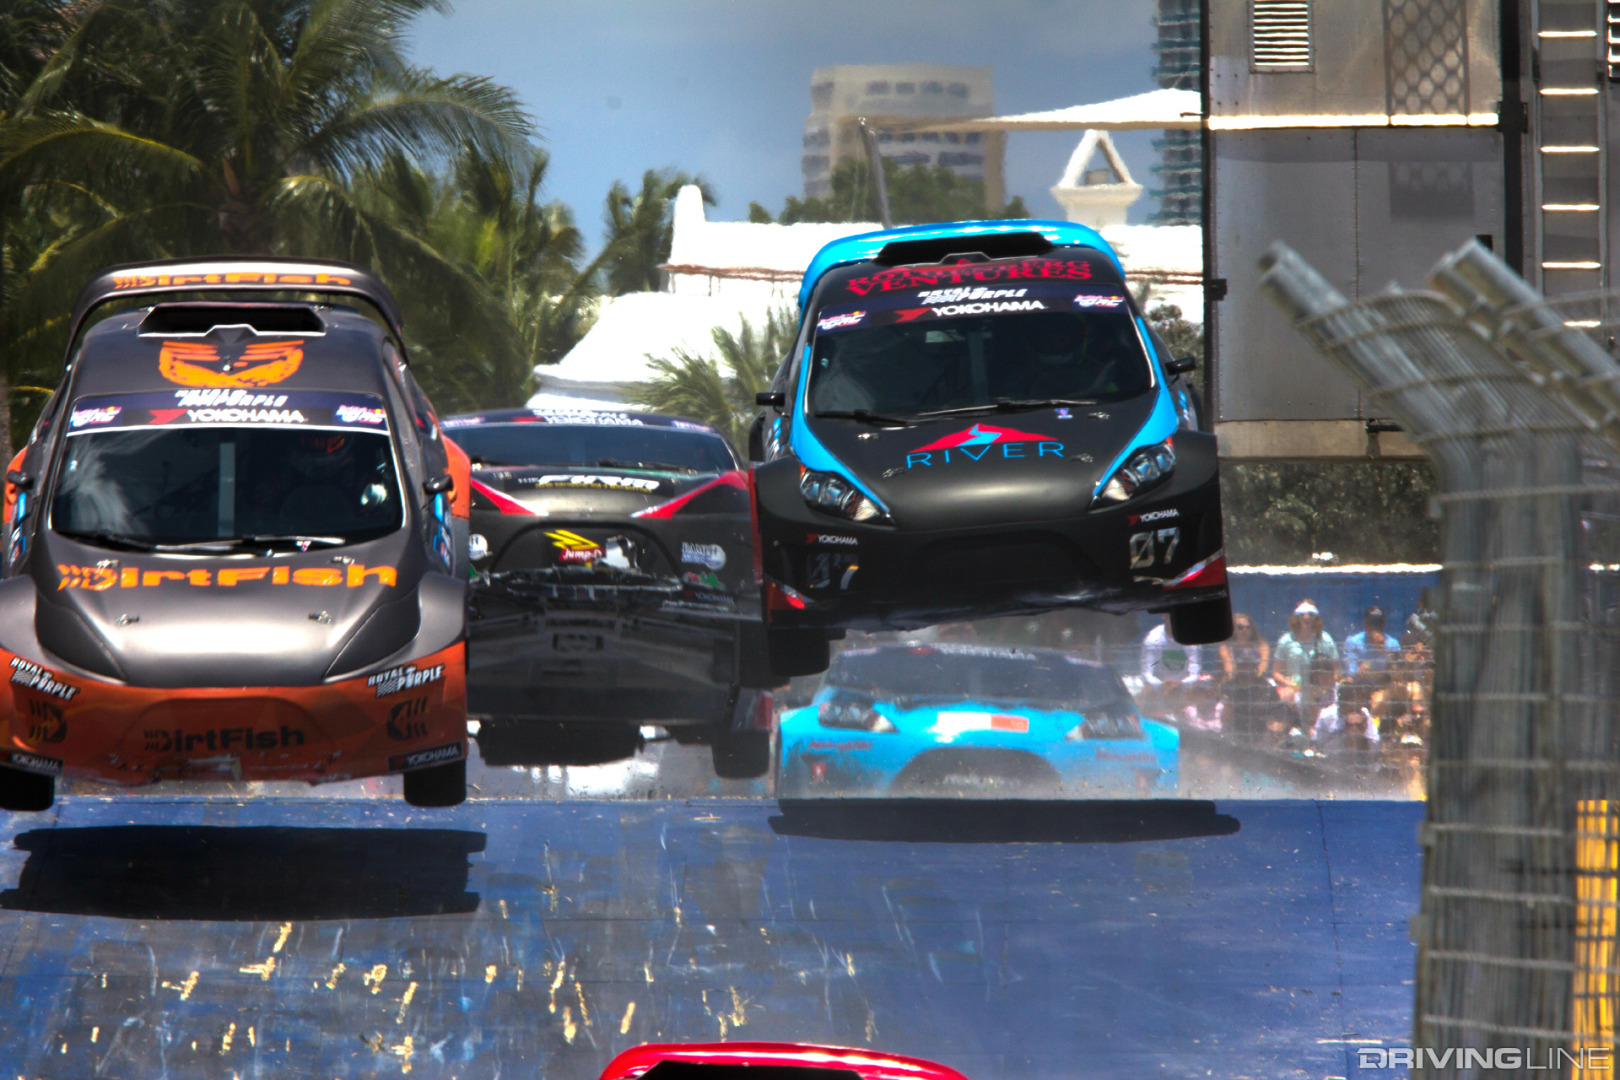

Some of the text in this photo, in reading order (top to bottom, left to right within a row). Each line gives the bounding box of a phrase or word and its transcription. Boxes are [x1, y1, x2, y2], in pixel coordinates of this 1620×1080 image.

[847, 266, 1092, 296] VENTURES
[931, 300, 1045, 316] YOKOHAMA
[187, 408, 304, 422] YOKOHAMA
[906, 441, 1065, 469] RIVER
[1139, 507, 1180, 523] YOKOHAMA
[818, 534, 859, 546] YOKOHAMA
[1129, 527, 1180, 569] 07
[58, 564, 398, 591] DirtFish
[10, 656, 77, 701] ROYAL PURPLE
[367, 664, 444, 692] ROYAL PURPLE
[143, 725, 305, 752] DirtFish
